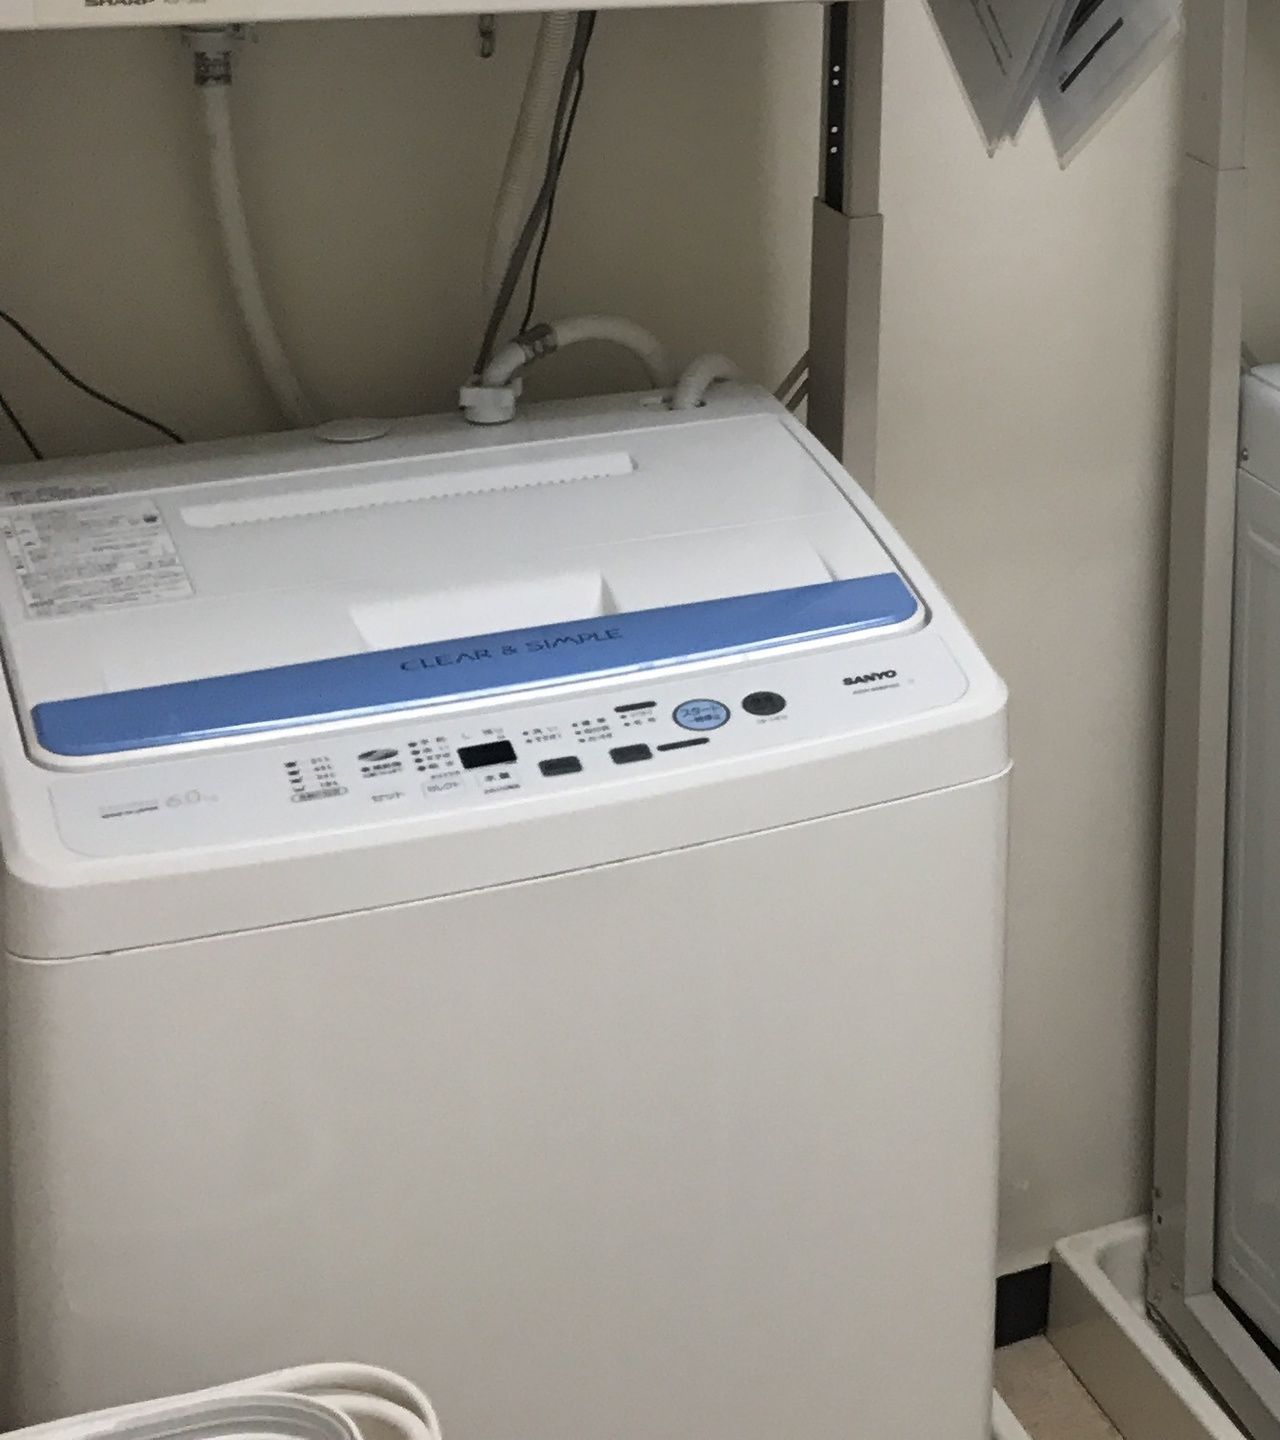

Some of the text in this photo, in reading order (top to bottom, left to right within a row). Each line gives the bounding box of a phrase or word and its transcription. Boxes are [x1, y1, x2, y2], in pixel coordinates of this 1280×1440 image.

[400, 628, 623, 672] CLEAR & SIMPLE
[843, 669, 897, 685] SANYO
[681, 705, 720, 717] スタート
